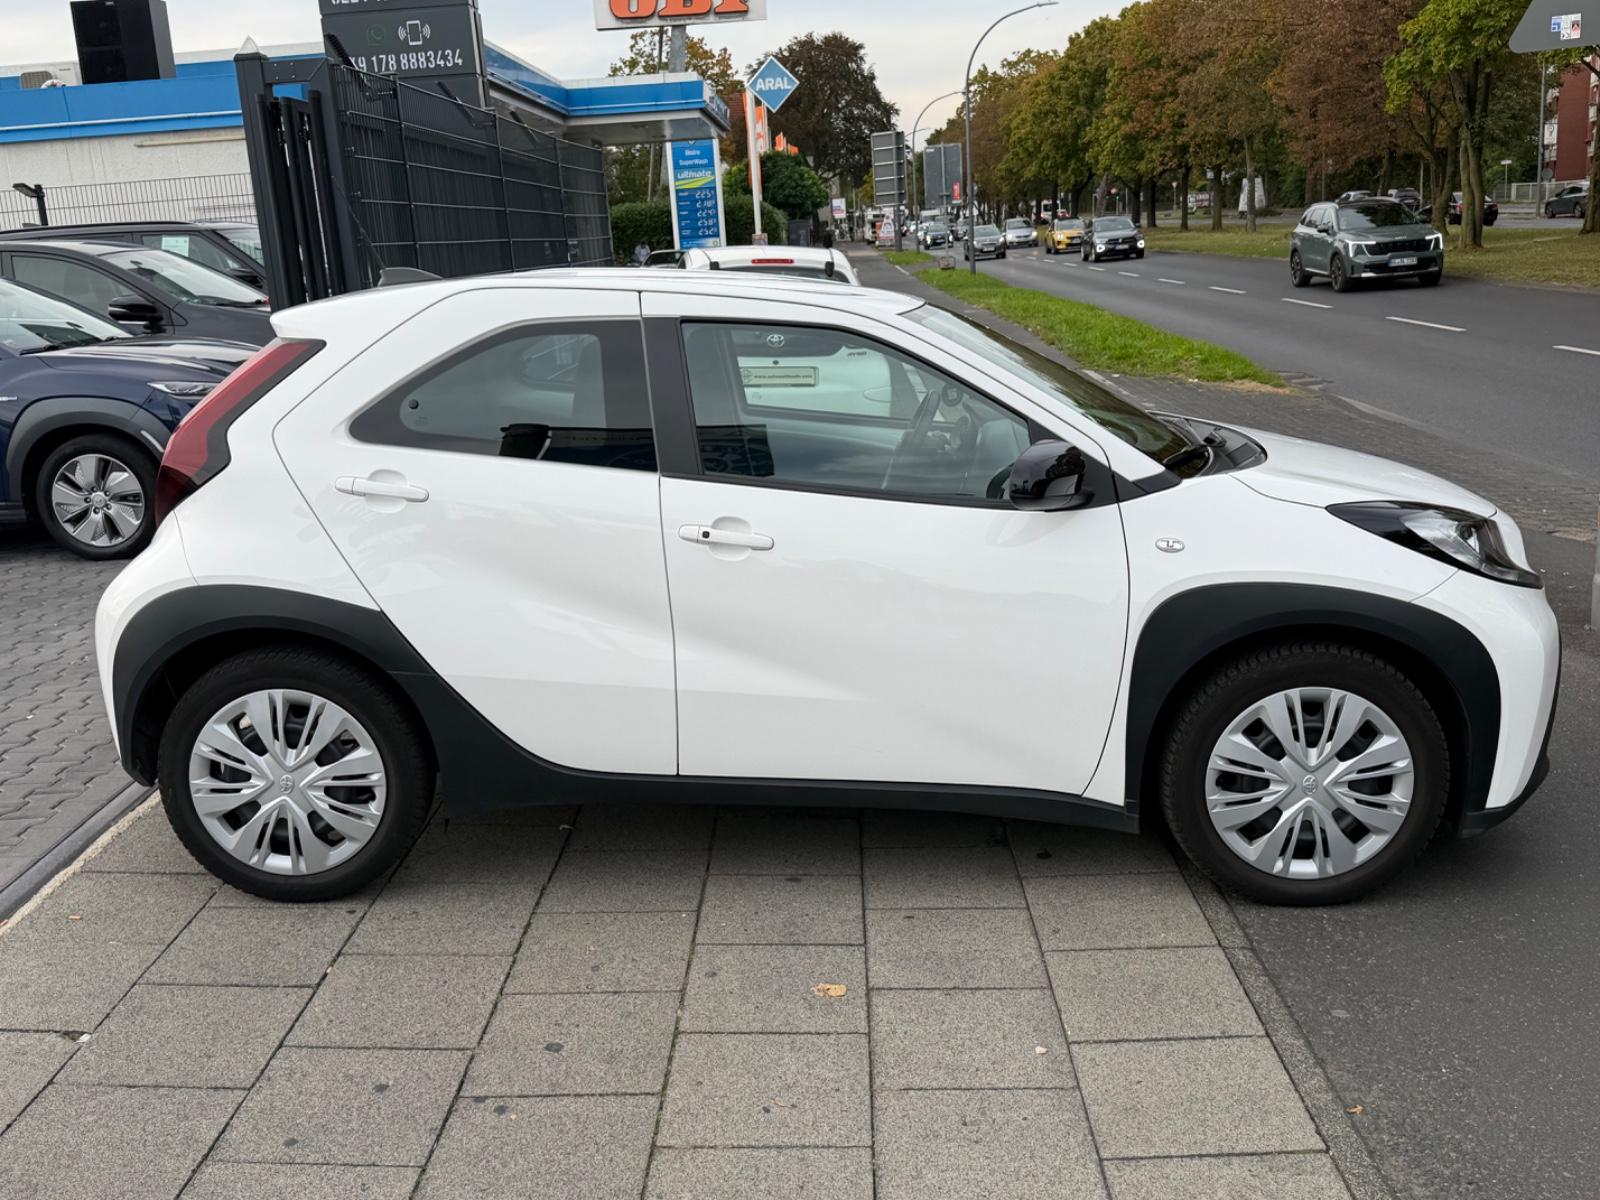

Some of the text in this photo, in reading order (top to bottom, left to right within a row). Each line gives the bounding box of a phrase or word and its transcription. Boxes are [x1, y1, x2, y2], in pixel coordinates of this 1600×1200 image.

[371, 54, 397, 73] 178
[400, 48, 463, 71] 8883434
[755, 77, 792, 91] ARAL
